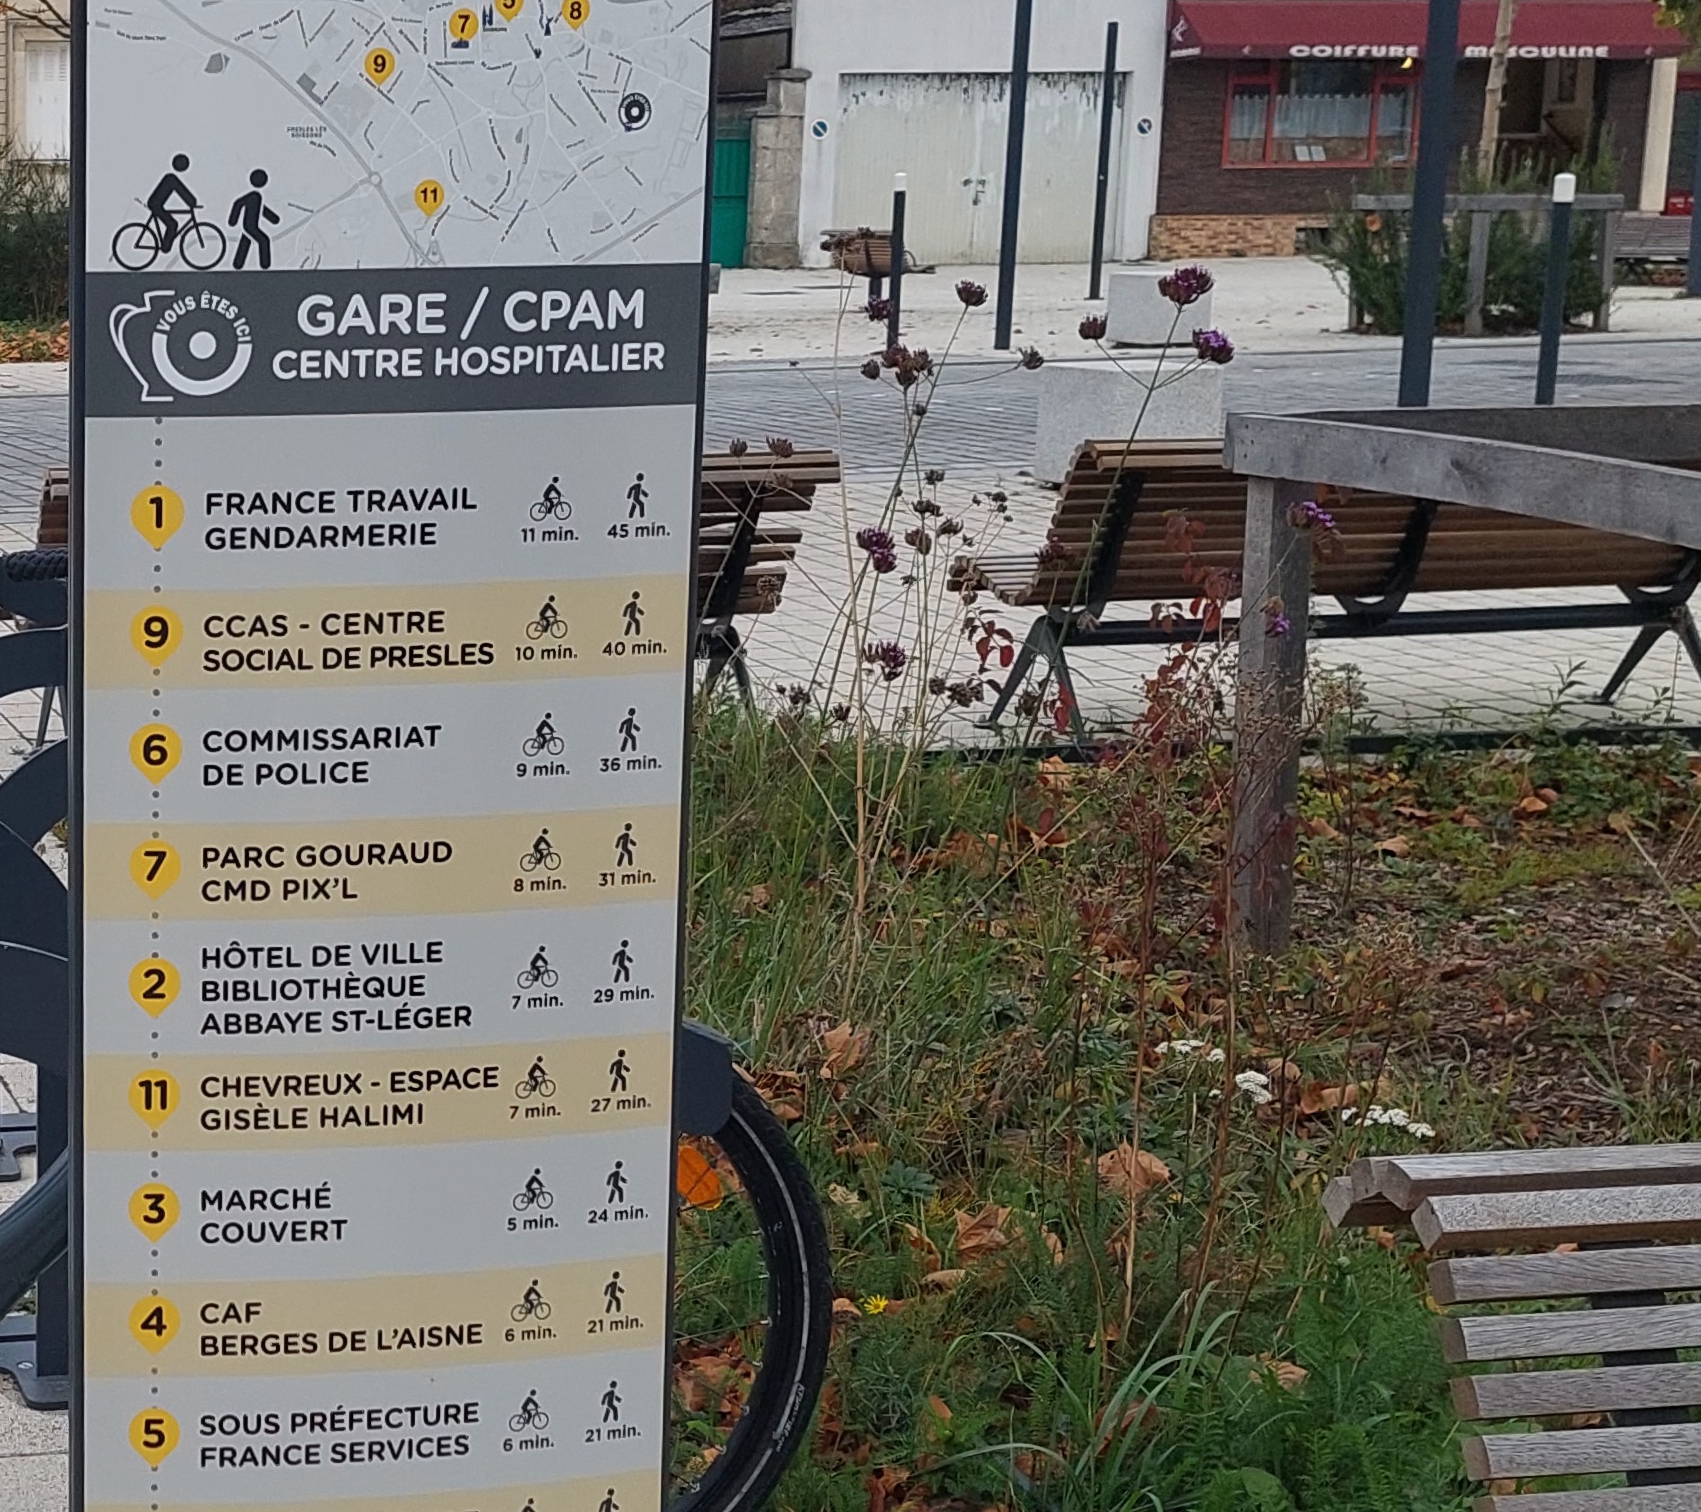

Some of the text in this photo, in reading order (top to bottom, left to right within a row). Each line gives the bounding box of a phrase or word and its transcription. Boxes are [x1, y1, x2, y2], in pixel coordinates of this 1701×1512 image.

[570, 1, 582, 20] 8
[458, 15, 470, 34] 7
[373, 54, 386, 74] 9
[1288, 45, 1419, 58] COIFFURE
[420, 186, 438, 204] 11
[157, 290, 252, 344] VOUS ÊTES ICI
[298, 287, 645, 340] GARE / CPAM
[272, 342, 665, 380] CENTRE HOSPITALIER
[148, 497, 164, 528] 1
[205, 488, 478, 516] FRANCE TRAVAIL
[204, 523, 438, 551] GENDARMERIE
[521, 527, 579, 543] 11 min.
[607, 523, 671, 539] 45 min.
[143, 616, 169, 649] 9
[203, 614, 288, 638] CCAS
[320, 610, 446, 636] CENTRE
[202, 643, 495, 672] SOCIAL DE PRESLES
[515, 644, 578, 661] 10 min.
[602, 639, 667, 657] 40 min.
[142, 734, 169, 767] 6
[202, 725, 442, 753] COMMISSARIAT
[202, 761, 369, 786] DE POLICE
[515, 760, 571, 777] 9 min.
[599, 755, 662, 773] 36 min.
[143, 850, 168, 882] 7
[202, 841, 453, 870] PARC GOURAUD
[201, 880, 270, 903] CMD
[513, 875, 567, 893] 8 min.
[599, 869, 657, 887] 31 min.
[201, 941, 444, 969] HÔTEL DE VILLE
[143, 968, 167, 999] 2
[201, 973, 426, 1002] BIBLIOTHÈQUE
[593, 987, 655, 1004] 29 min.
[511, 992, 564, 1009] 7 min.
[200, 1002, 473, 1035] ABBAYE ST-LÉGER
[138, 1079, 168, 1110] 11
[201, 1073, 363, 1098] CHEVREUX
[390, 1066, 500, 1094] ESPACE
[200, 1102, 424, 1131] GISÈLE HALIMI
[509, 1103, 562, 1120] 7 min.
[590, 1095, 652, 1113] 27 min.
[143, 1193, 166, 1224] 3
[201, 1182, 332, 1211] MARCHÉ
[507, 1215, 559, 1232] 5 min.
[588, 1207, 649, 1225] 24 min.
[200, 1219, 349, 1245] COUVERT
[140, 1306, 168, 1337] 4
[200, 1302, 263, 1325] CAF
[586, 1316, 644, 1334] 21 min.
[200, 1332, 319, 1357] BERGES
[328, 1329, 368, 1353] DE
[504, 1324, 558, 1342] 6 min.
[199, 1402, 480, 1437] SOUS PRÉFECTURE
[143, 1418, 166, 1449] 5
[503, 1434, 555, 1452] 6 min.
[585, 1424, 642, 1443] 21 min.
[200, 1435, 470, 1468] FRANCE SERVICES
